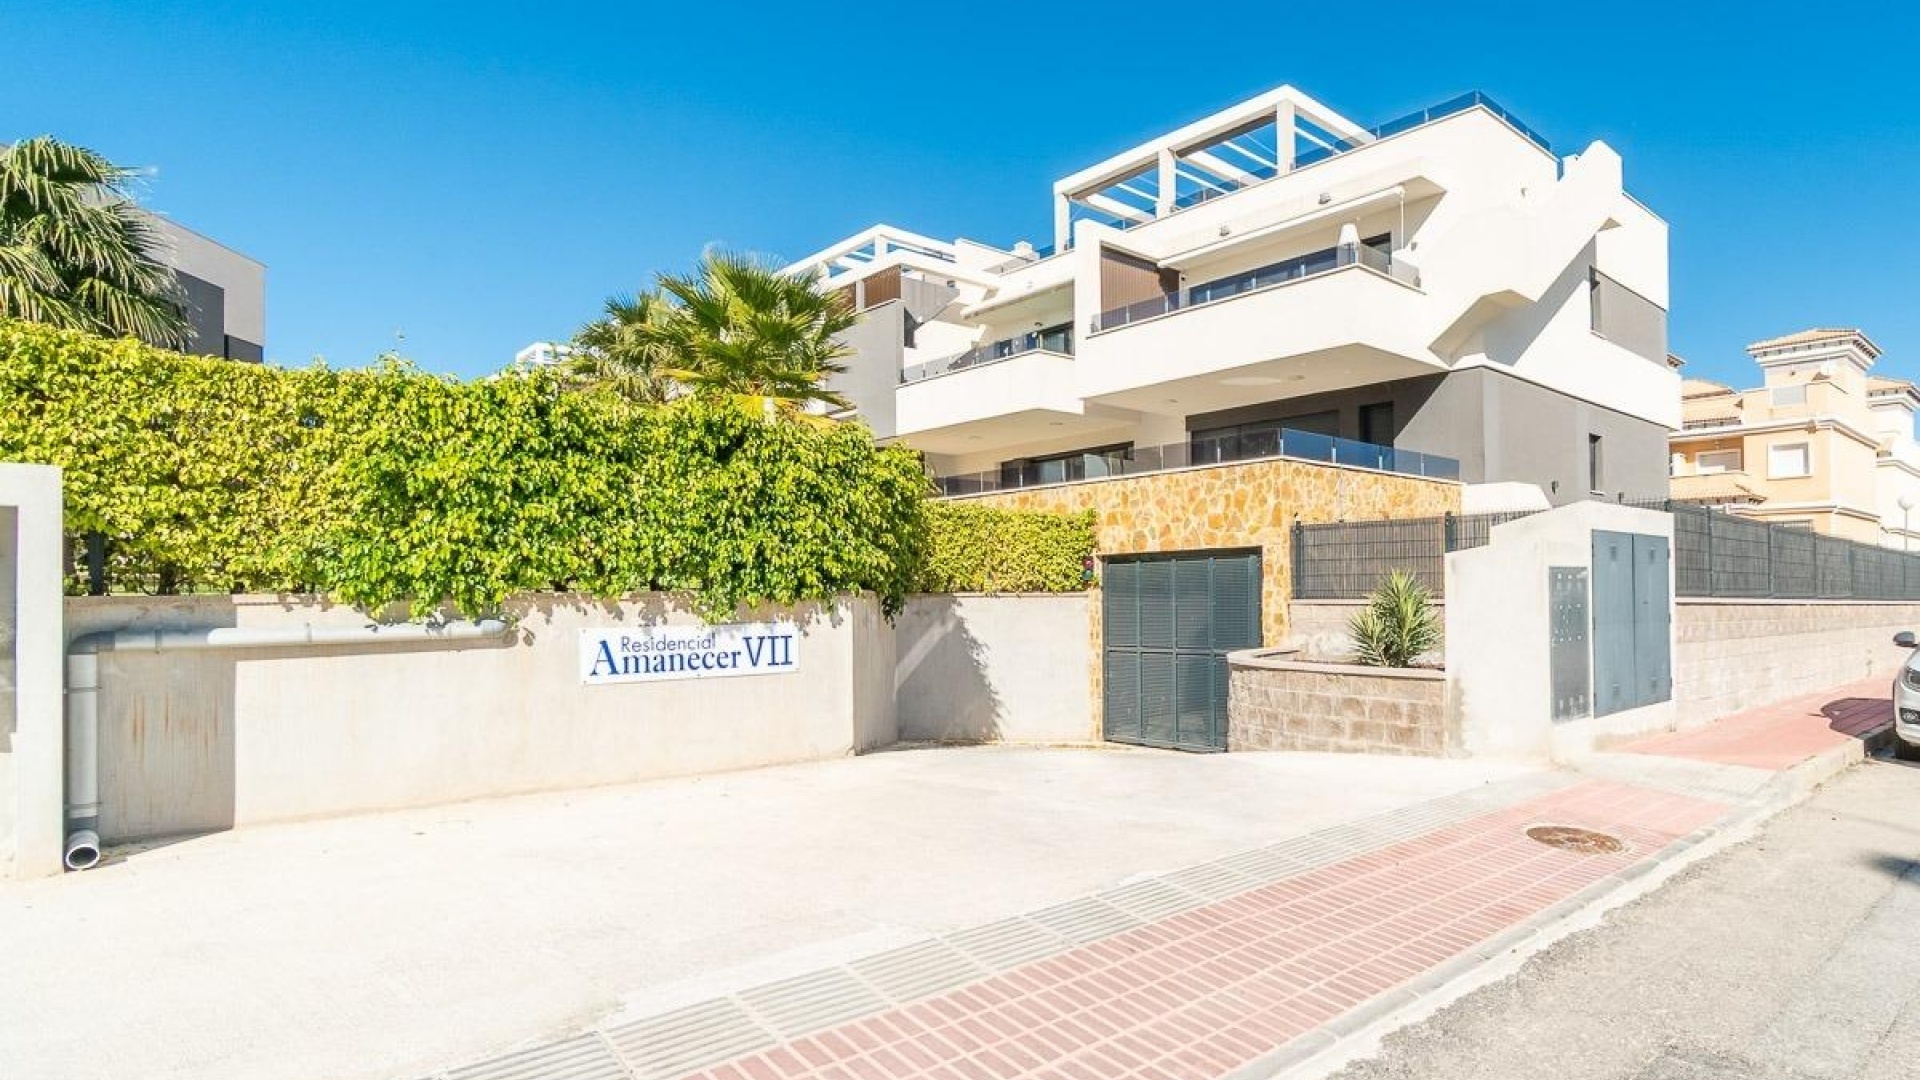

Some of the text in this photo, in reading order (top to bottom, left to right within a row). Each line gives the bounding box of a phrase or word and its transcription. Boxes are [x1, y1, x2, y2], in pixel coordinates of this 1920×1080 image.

[589, 635, 793, 676] Amanecer VII
[621, 633, 716, 653] Residencial
